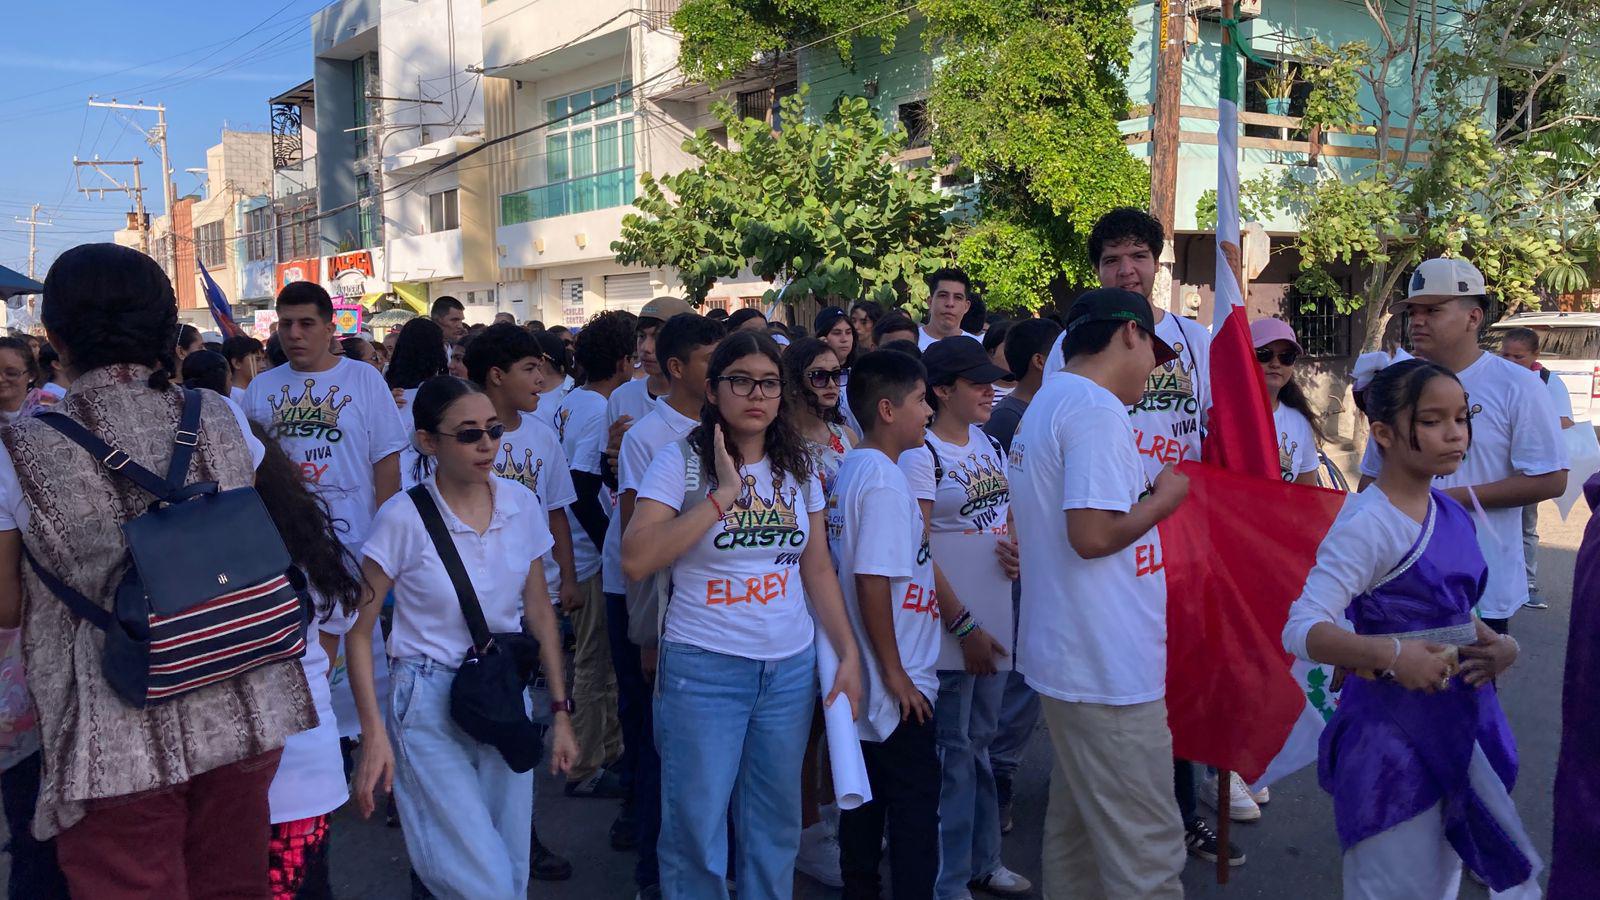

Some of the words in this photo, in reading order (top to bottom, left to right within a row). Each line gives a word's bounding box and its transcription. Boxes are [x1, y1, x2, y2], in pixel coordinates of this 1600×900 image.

[1147, 373, 1178, 390] IVA
[281, 407, 321, 421] VIVA
[1128, 393, 1198, 415] RISTO
[277, 421, 343, 443] RISTO
[1171, 418, 1197, 438] VIVA
[305, 446, 332, 462] VIVA
[973, 476, 1001, 498] VIVA
[735, 509, 780, 528] VIVA
[973, 506, 998, 531] VIVA
[714, 529, 805, 549] CRISTO
